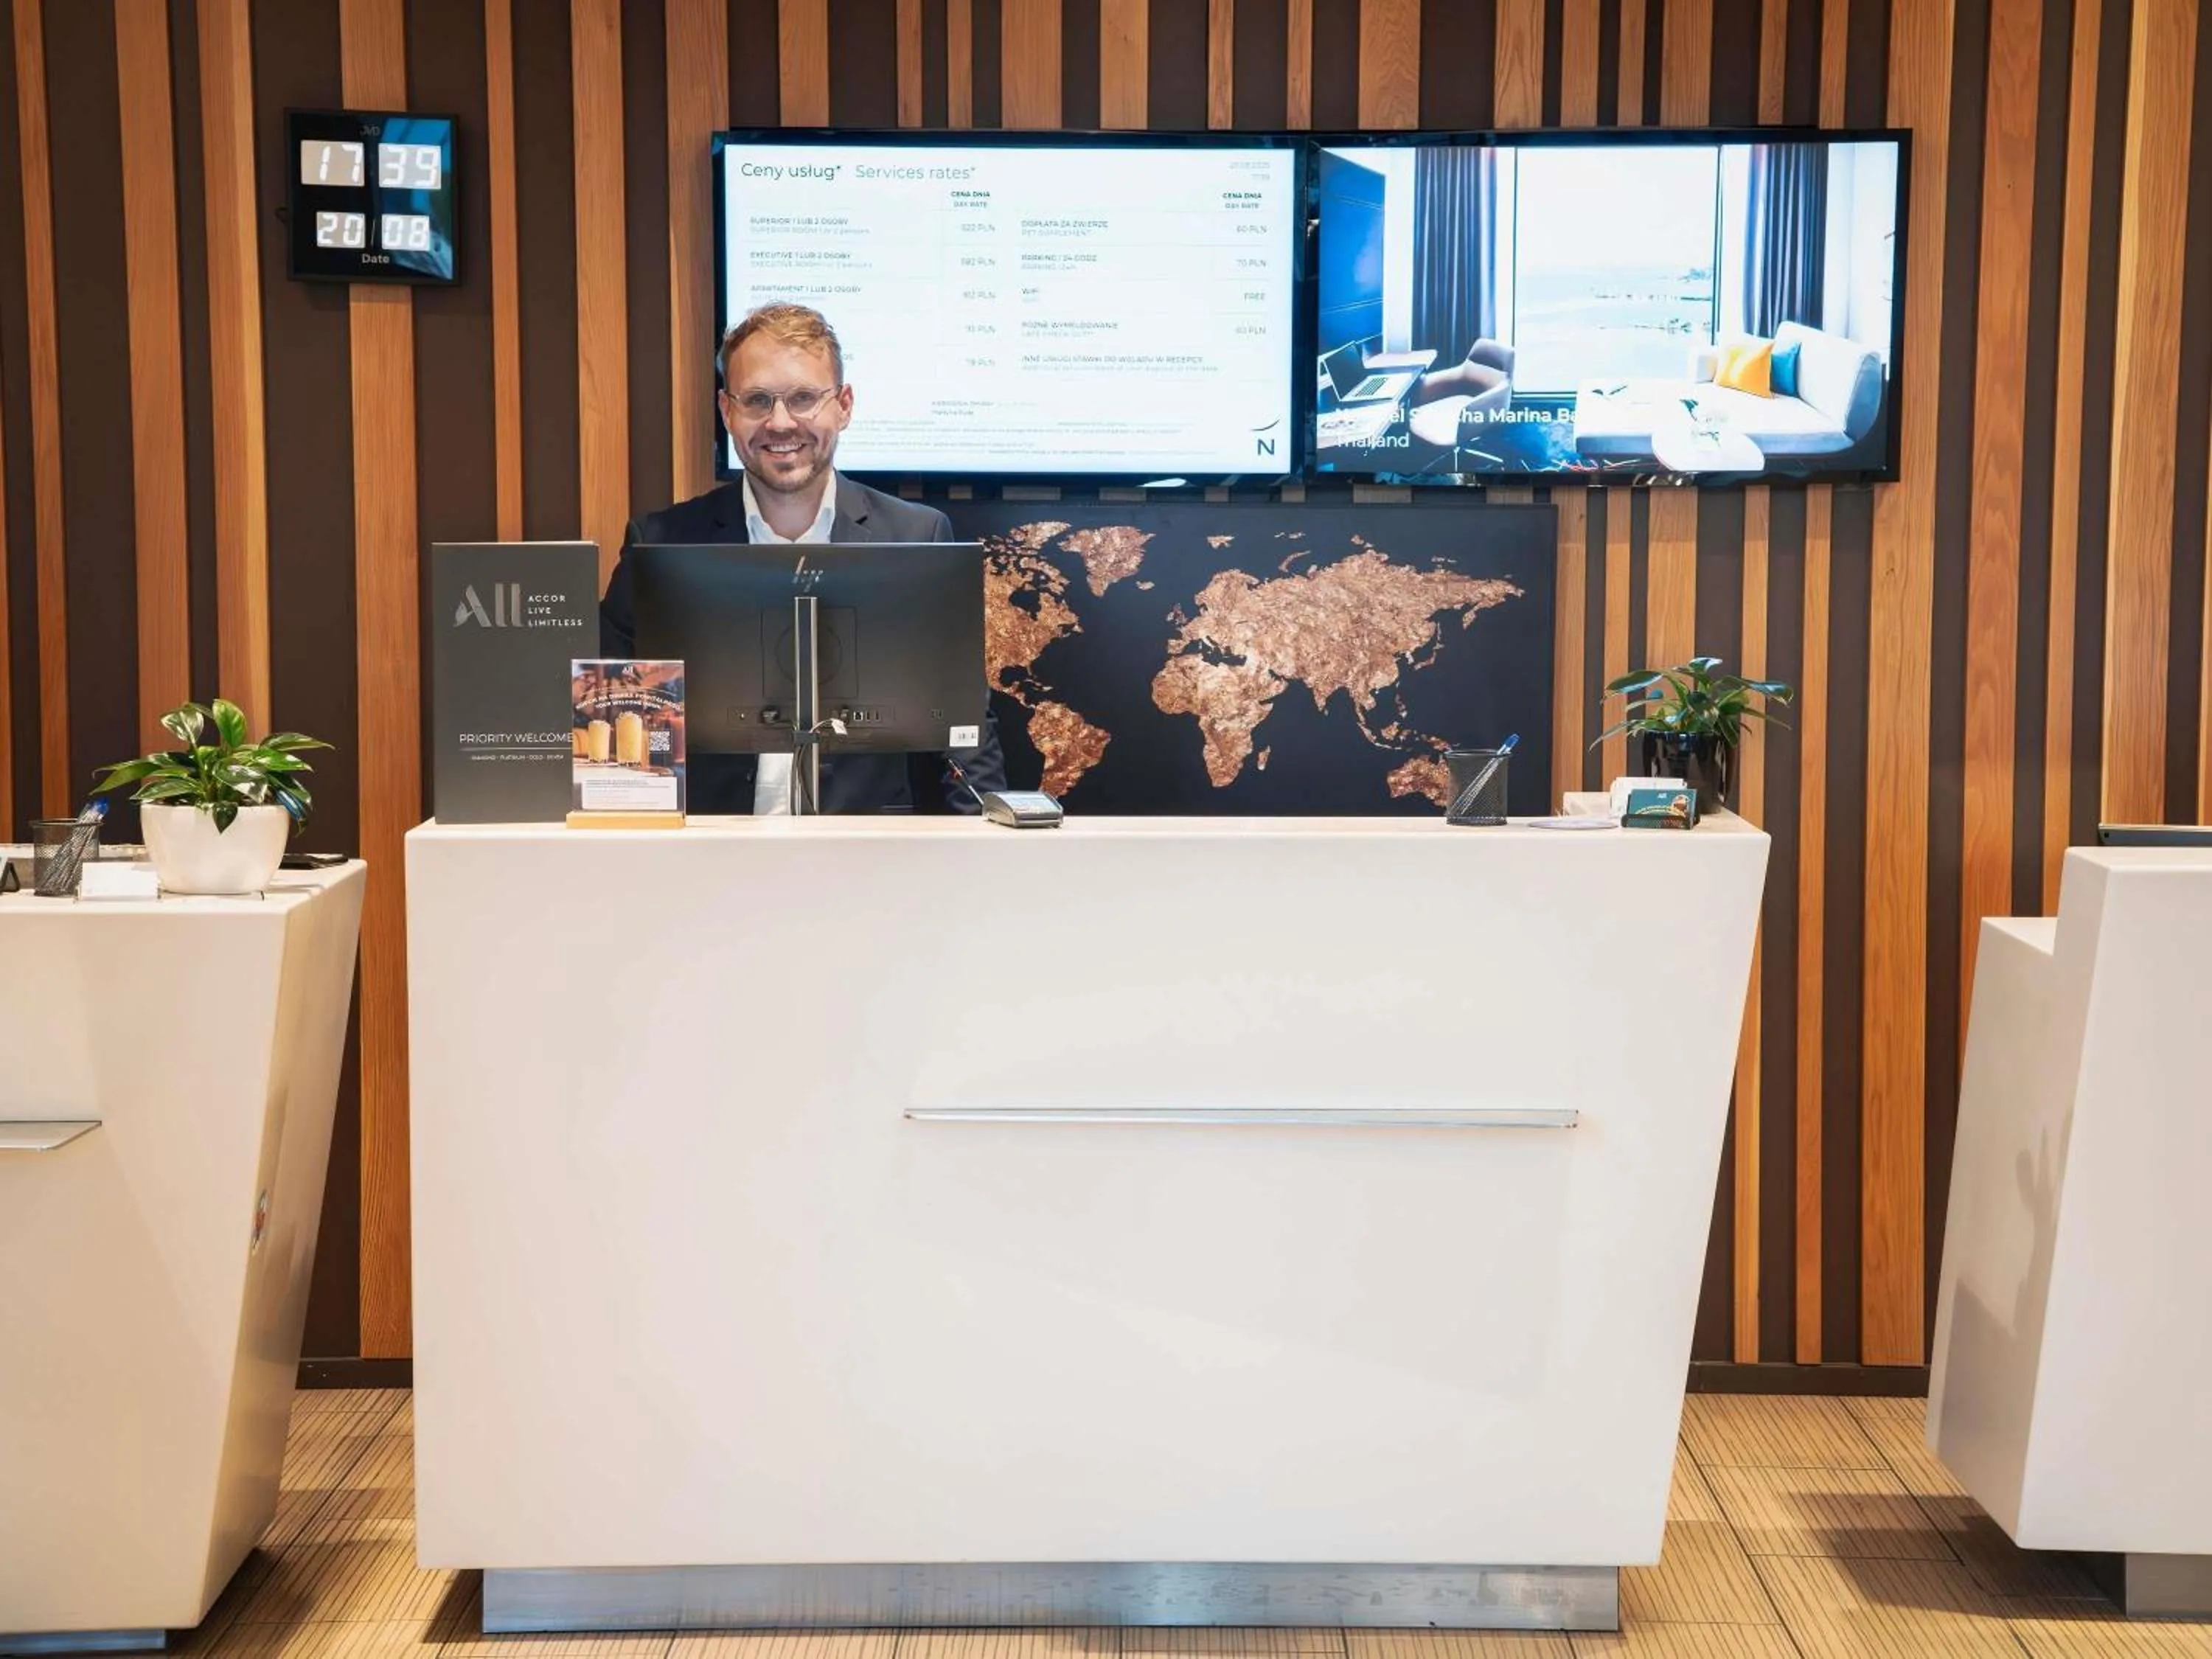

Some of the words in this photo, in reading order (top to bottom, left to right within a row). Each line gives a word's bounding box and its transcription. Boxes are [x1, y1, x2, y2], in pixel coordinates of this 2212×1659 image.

[319, 144, 363, 182] 17
[382, 146, 440, 186] 39
[741, 163, 782, 181] Ceny
[855, 164, 925, 179] Services
[317, 214, 364, 246] 20
[383, 215, 428, 247] 08
[361, 253, 390, 264] Date
[1489, 407, 1552, 423] Marina
[1257, 438, 1275, 456] N
[527, 619, 583, 627] LIMITLESS
[459, 733, 512, 744] PRIORITY
[515, 732, 574, 742] WELCOME
